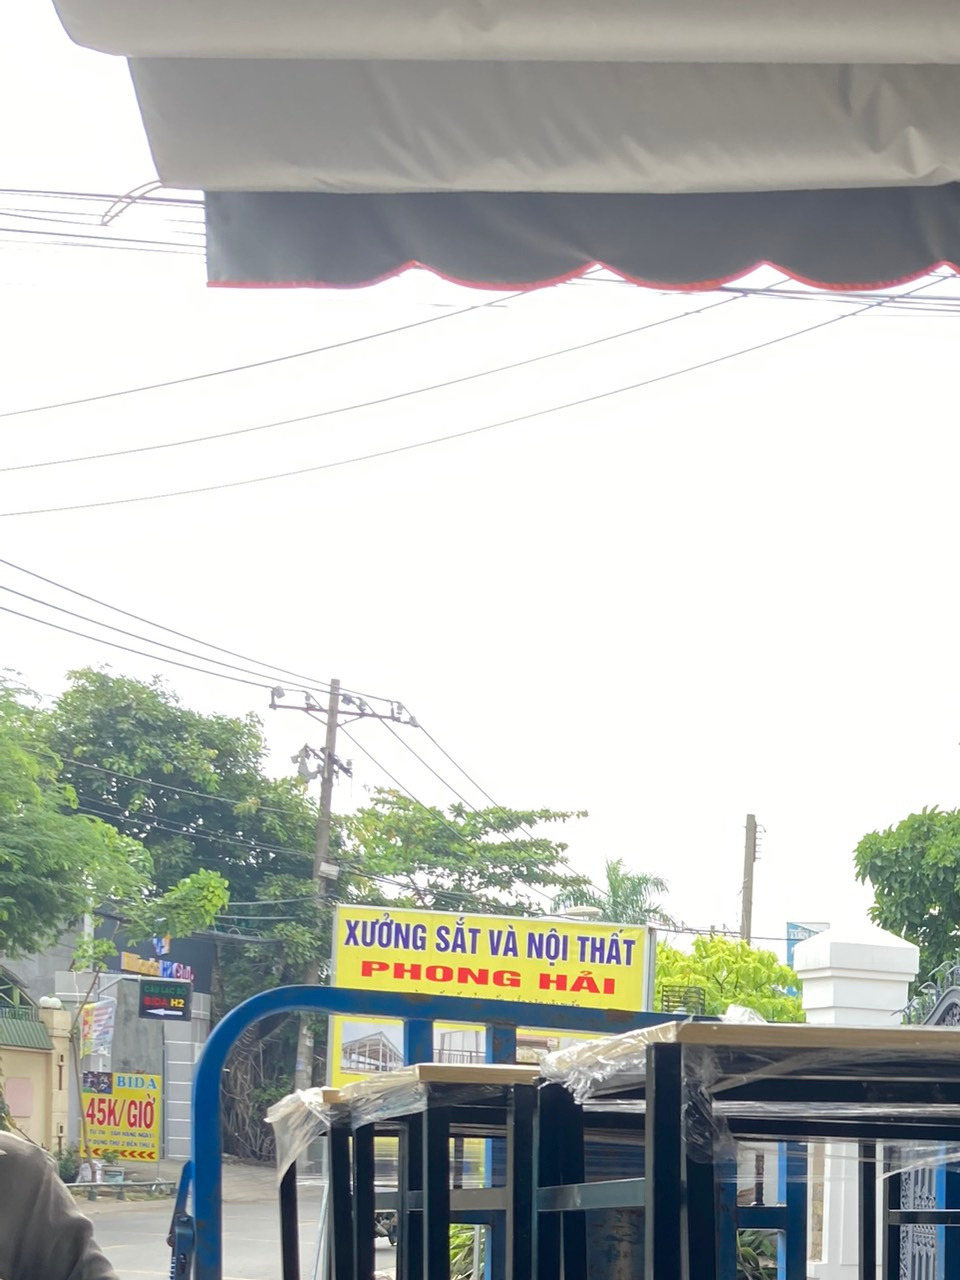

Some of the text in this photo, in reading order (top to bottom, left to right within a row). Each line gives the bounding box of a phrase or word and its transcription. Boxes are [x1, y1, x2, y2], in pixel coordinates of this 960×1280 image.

[344, 913, 636, 966] XƯỞNG SẮT VÀ NỘI THẤT
[361, 960, 615, 995] PHONG HẢI
[144, 996, 184, 1007] BIDA H2
[116, 1075, 158, 1090] BIDA
